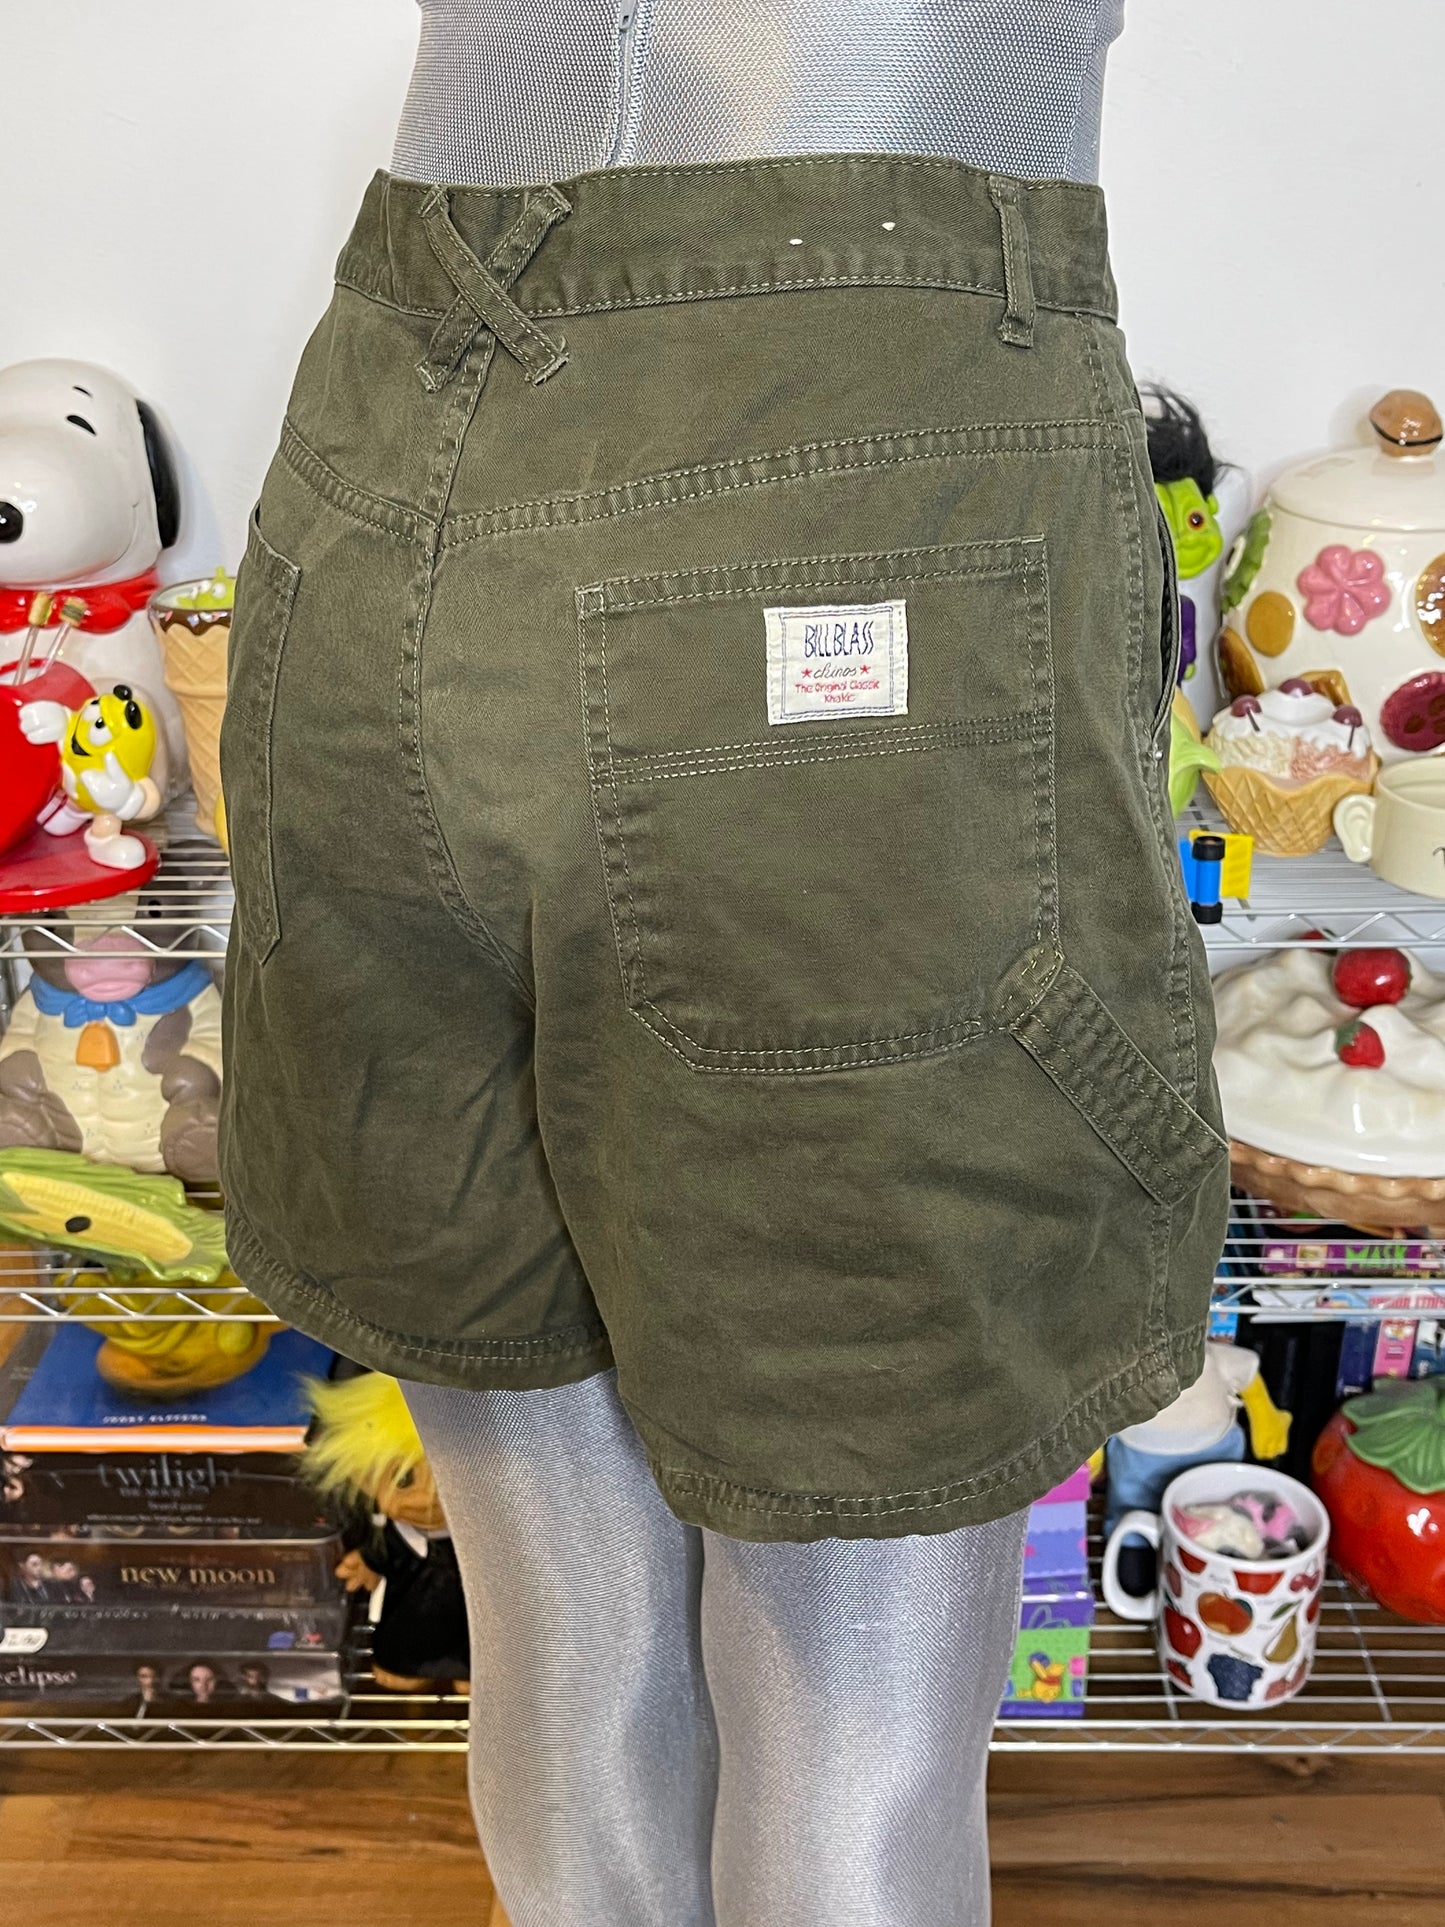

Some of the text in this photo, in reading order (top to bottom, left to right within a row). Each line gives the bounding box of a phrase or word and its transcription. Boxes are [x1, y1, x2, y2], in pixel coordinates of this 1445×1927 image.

[804, 620, 874, 658] BILL BLASS
[813, 662, 857, 679] chinos
[795, 678, 880, 694] The Original Classic
[1345, 1242, 1407, 1269] MASK
[120, 1566, 276, 1585] new moon
